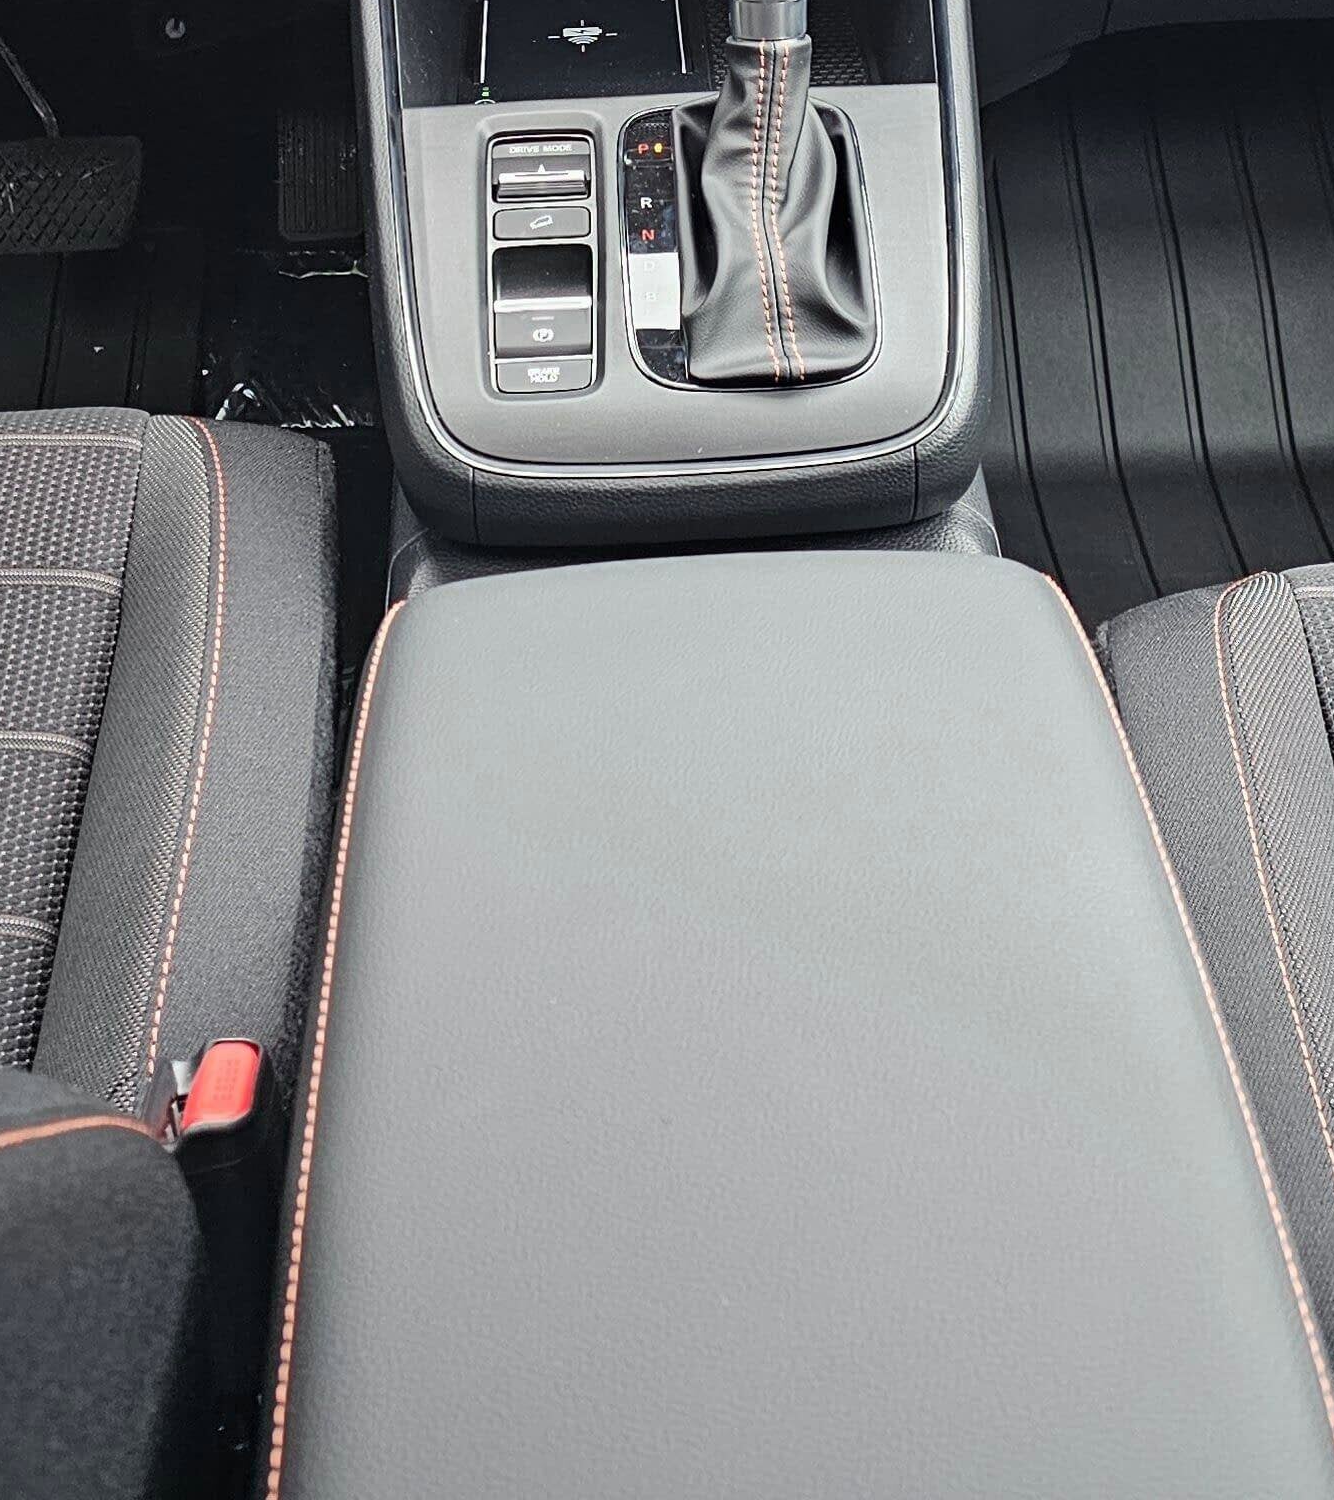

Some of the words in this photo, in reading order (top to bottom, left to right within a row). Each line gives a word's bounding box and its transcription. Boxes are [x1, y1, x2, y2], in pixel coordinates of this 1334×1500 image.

[637, 143, 649, 154] P
[640, 197, 653, 209] R
[641, 229, 655, 242] N
[644, 260, 655, 272] D
